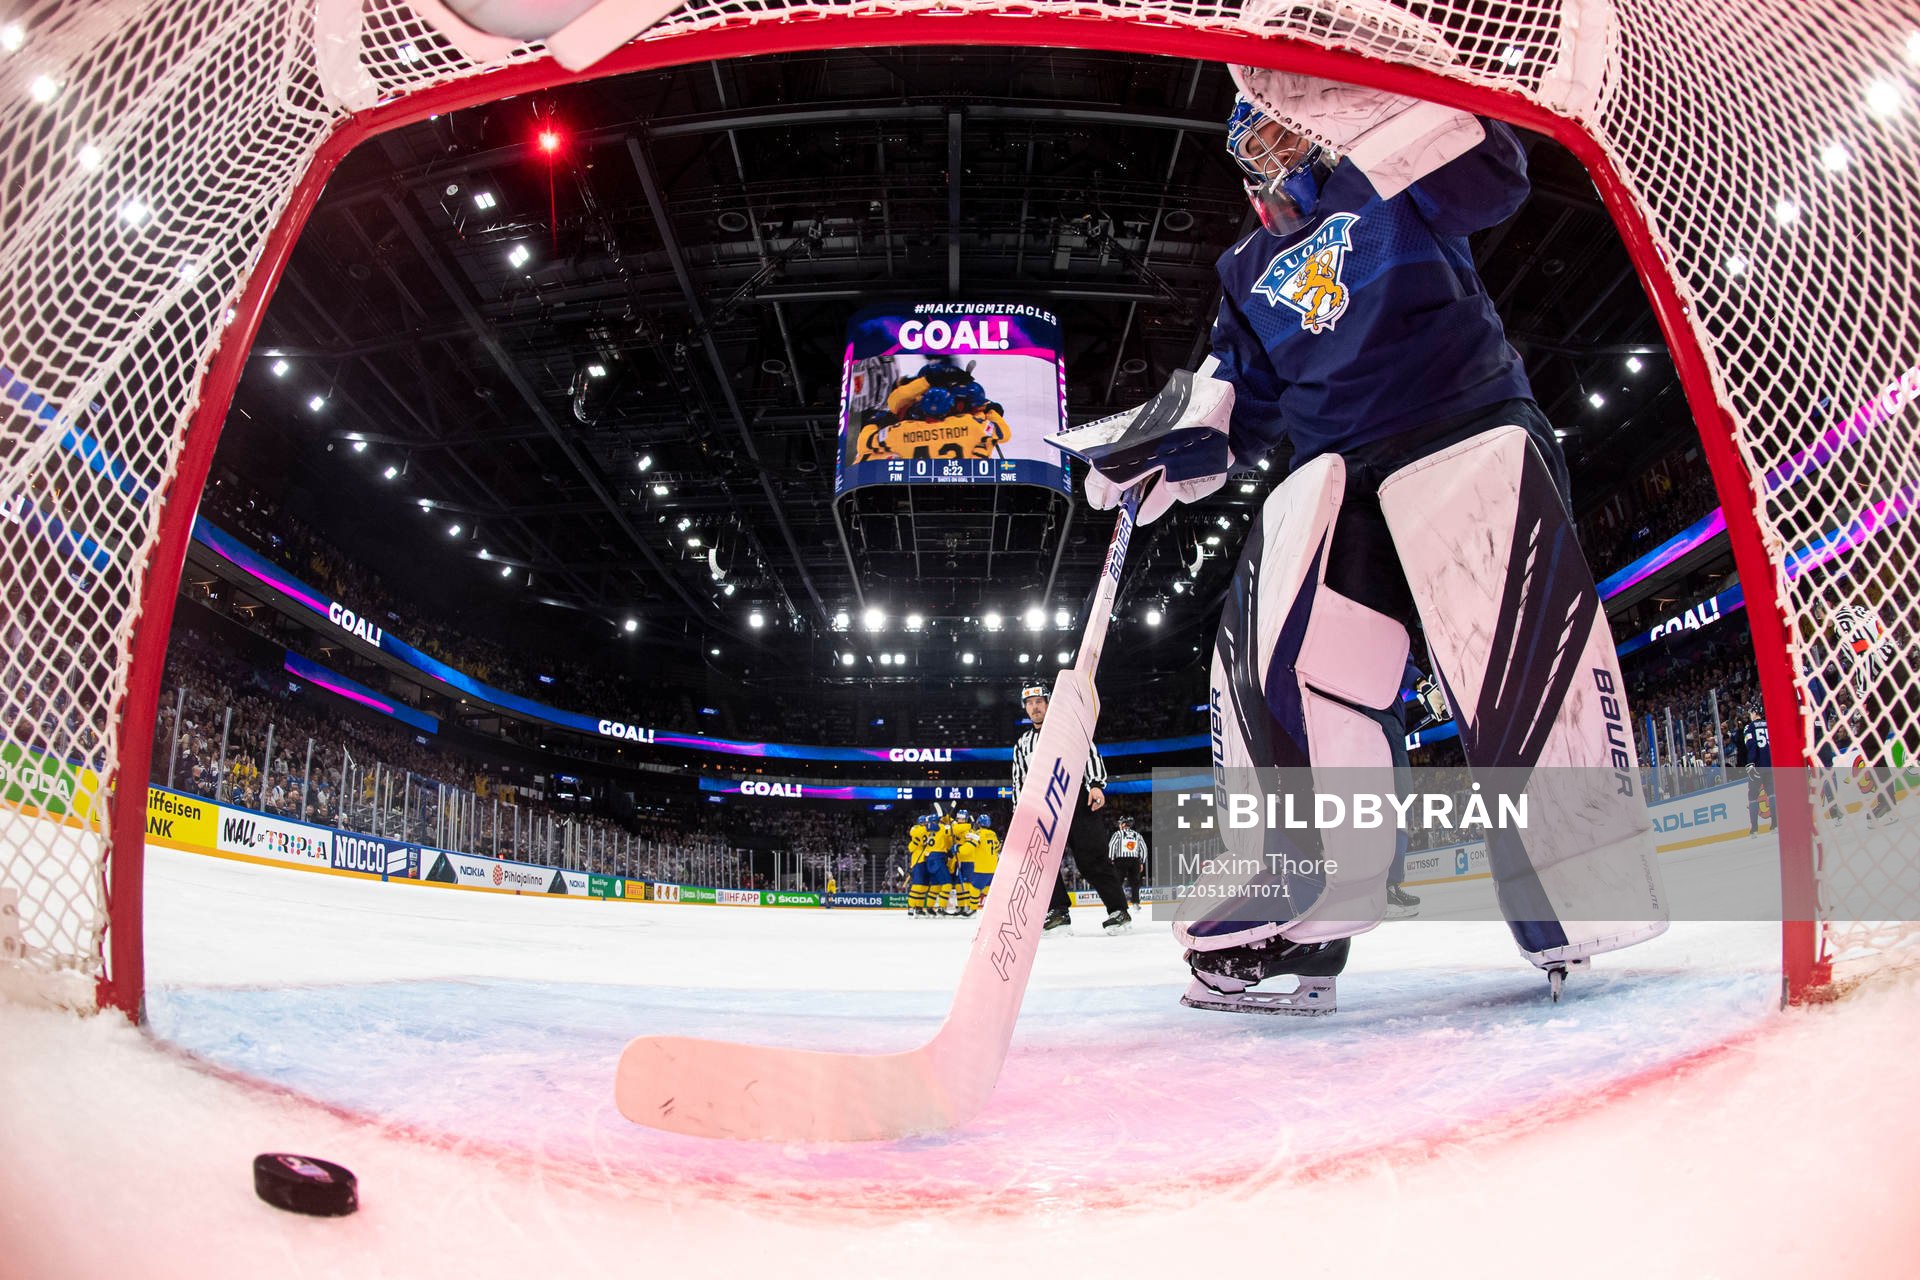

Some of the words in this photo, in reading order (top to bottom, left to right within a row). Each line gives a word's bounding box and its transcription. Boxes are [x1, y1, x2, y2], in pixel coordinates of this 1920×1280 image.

[1273, 226, 1334, 280] SUOMI
[914, 303, 1057, 326] #MAKINGMIRACLES
[898, 320, 1009, 350] GOAL!
[916, 460, 926, 475] 0
[943, 466, 963, 476] 8:22
[979, 460, 989, 475] 0
[890, 473, 902, 482] FIN
[1000, 473, 1017, 482] SWE
[328, 602, 383, 648] GOAL!
[598, 719, 655, 744] GOAL!
[1592, 667, 1634, 798] BAUER
[889, 747, 952, 763] GOAL!
[740, 780, 802, 798] GOAL!
[935, 787, 942, 799] 0
[966, 787, 974, 799] 0
[223, 817, 256, 848] MALL
[257, 834, 265, 843] OF
[266, 830, 328, 860] TRIPLA
[334, 835, 385, 872] NOCCO
[1470, 849, 1489, 861] CON
[1415, 857, 1440, 869] TISSOT
[460, 865, 485, 878] NOKIA
[504, 870, 543, 887] Pihlajalinna
[569, 879, 585, 889] NOKIA
[778, 894, 814, 904] ŠKODA
